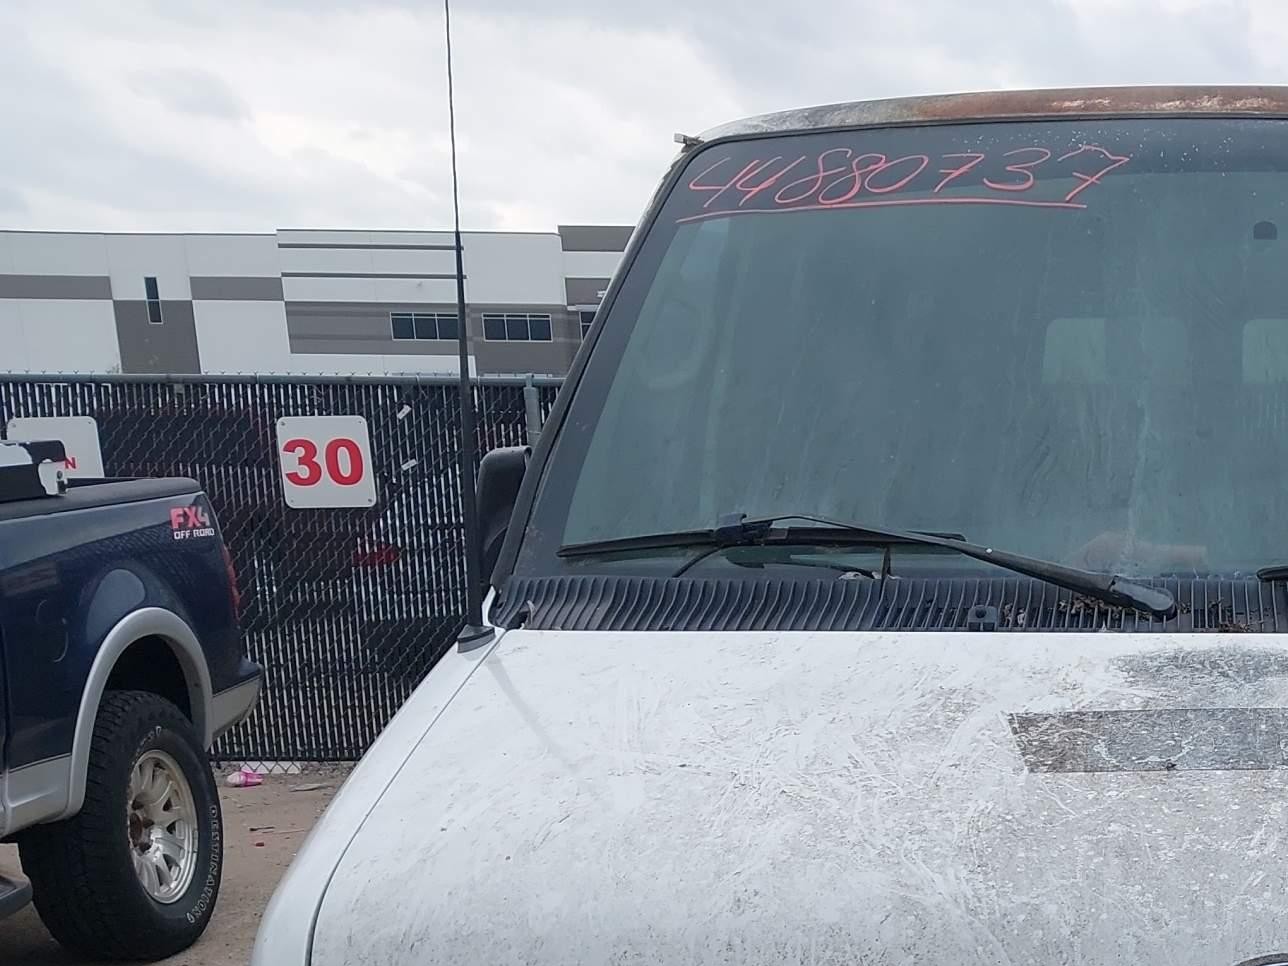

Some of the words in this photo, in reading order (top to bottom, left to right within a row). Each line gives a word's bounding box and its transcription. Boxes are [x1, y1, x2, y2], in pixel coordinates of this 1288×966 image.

[688, 145, 1130, 207] 44880737
[282, 438, 364, 487] 30
[170, 505, 210, 529] FX4
[173, 530, 191, 540] OFF
[193, 528, 215, 537] ROAD
